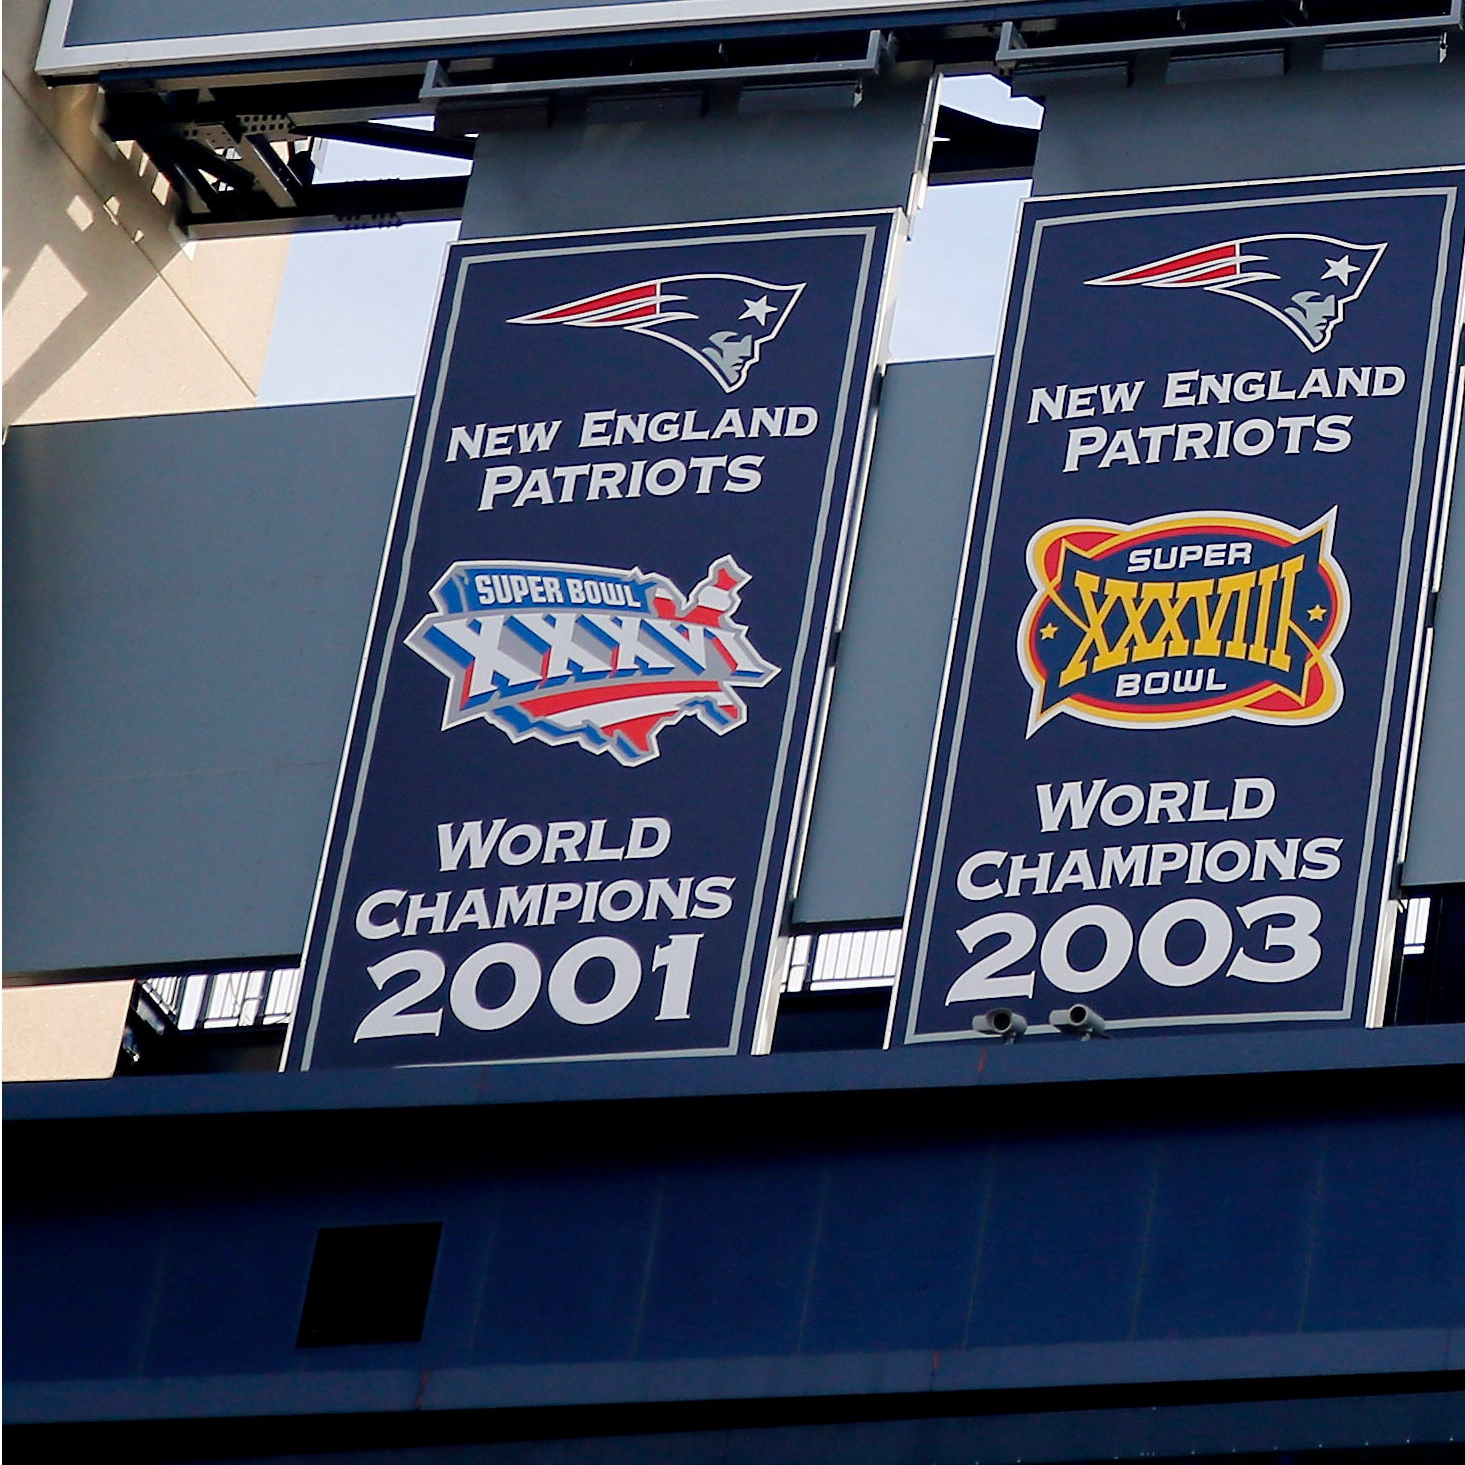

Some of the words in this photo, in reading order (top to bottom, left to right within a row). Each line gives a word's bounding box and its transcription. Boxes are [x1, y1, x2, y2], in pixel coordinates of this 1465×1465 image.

[1026, 380, 1146, 424] NEW
[1162, 366, 1406, 408] ENGLAND
[445, 420, 563, 463] NEW
[578, 406, 818, 448] ENGLAND
[1062, 414, 1354, 473] PATRIOTS
[477, 454, 765, 512] PATRIOTS
[1127, 541, 1253, 573] SUPER
[474, 573, 564, 607] SUPER
[567, 579, 643, 609] BOWL
[1058, 553, 1306, 688] XXXVIII
[430, 612, 766, 702] XXXVI
[1115, 667, 1227, 698] BOWL
[1036, 777, 1276, 833] WORLD
[437, 817, 671, 872] WORLD
[956, 837, 1344, 901] CHAMPIONS
[355, 876, 736, 940] CHAMPIONS
[944, 895, 1322, 1007] 2003
[353, 933, 705, 1044] 2001
